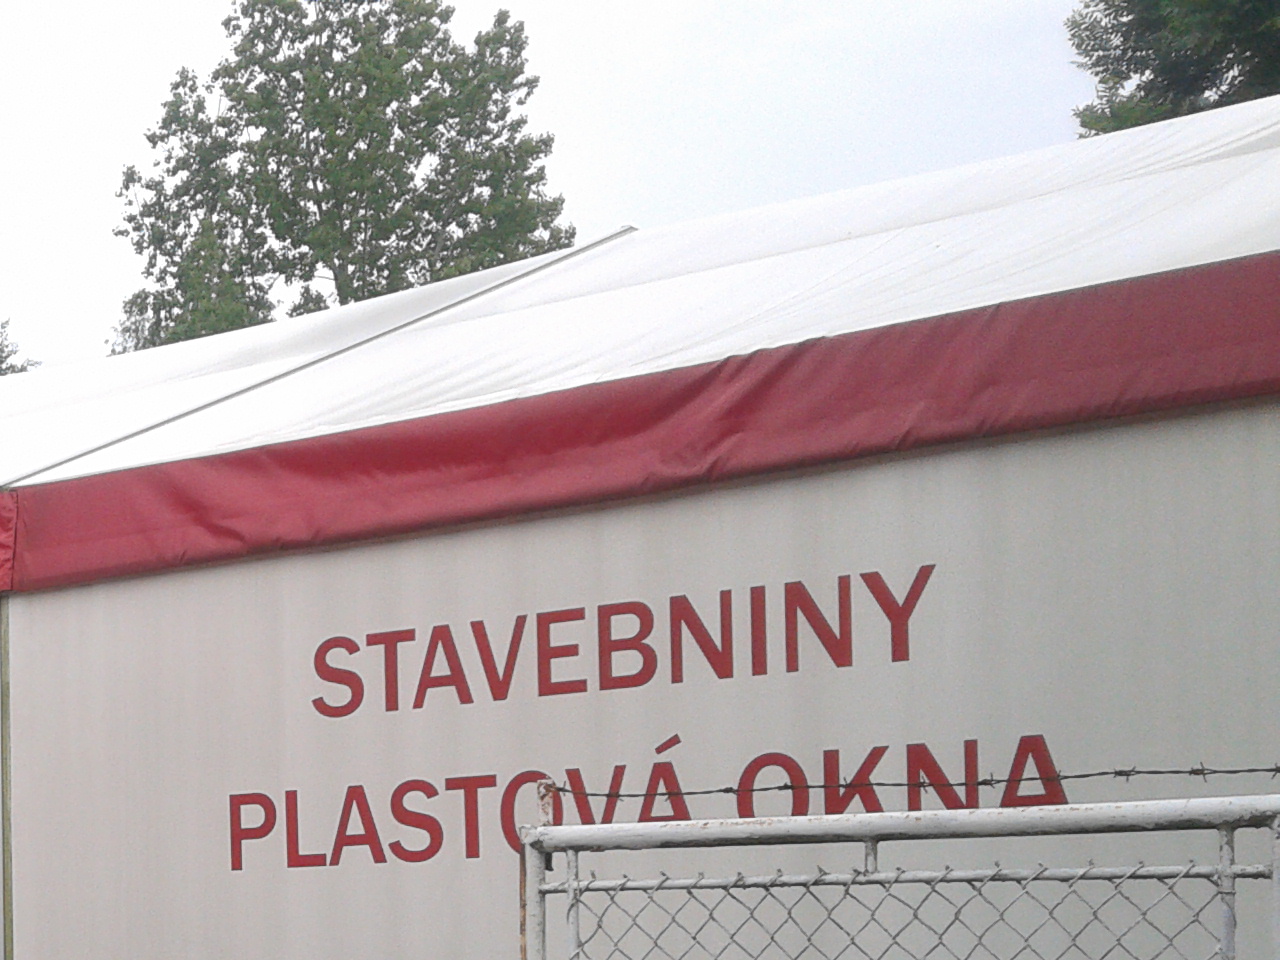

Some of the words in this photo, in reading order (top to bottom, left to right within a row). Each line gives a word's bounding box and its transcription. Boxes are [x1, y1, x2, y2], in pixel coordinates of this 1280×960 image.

[310, 564, 936, 719] STAVEBNINY
[228, 733, 689, 872] PLASTOVÁ
[736, 734, 1069, 819] OKNA
